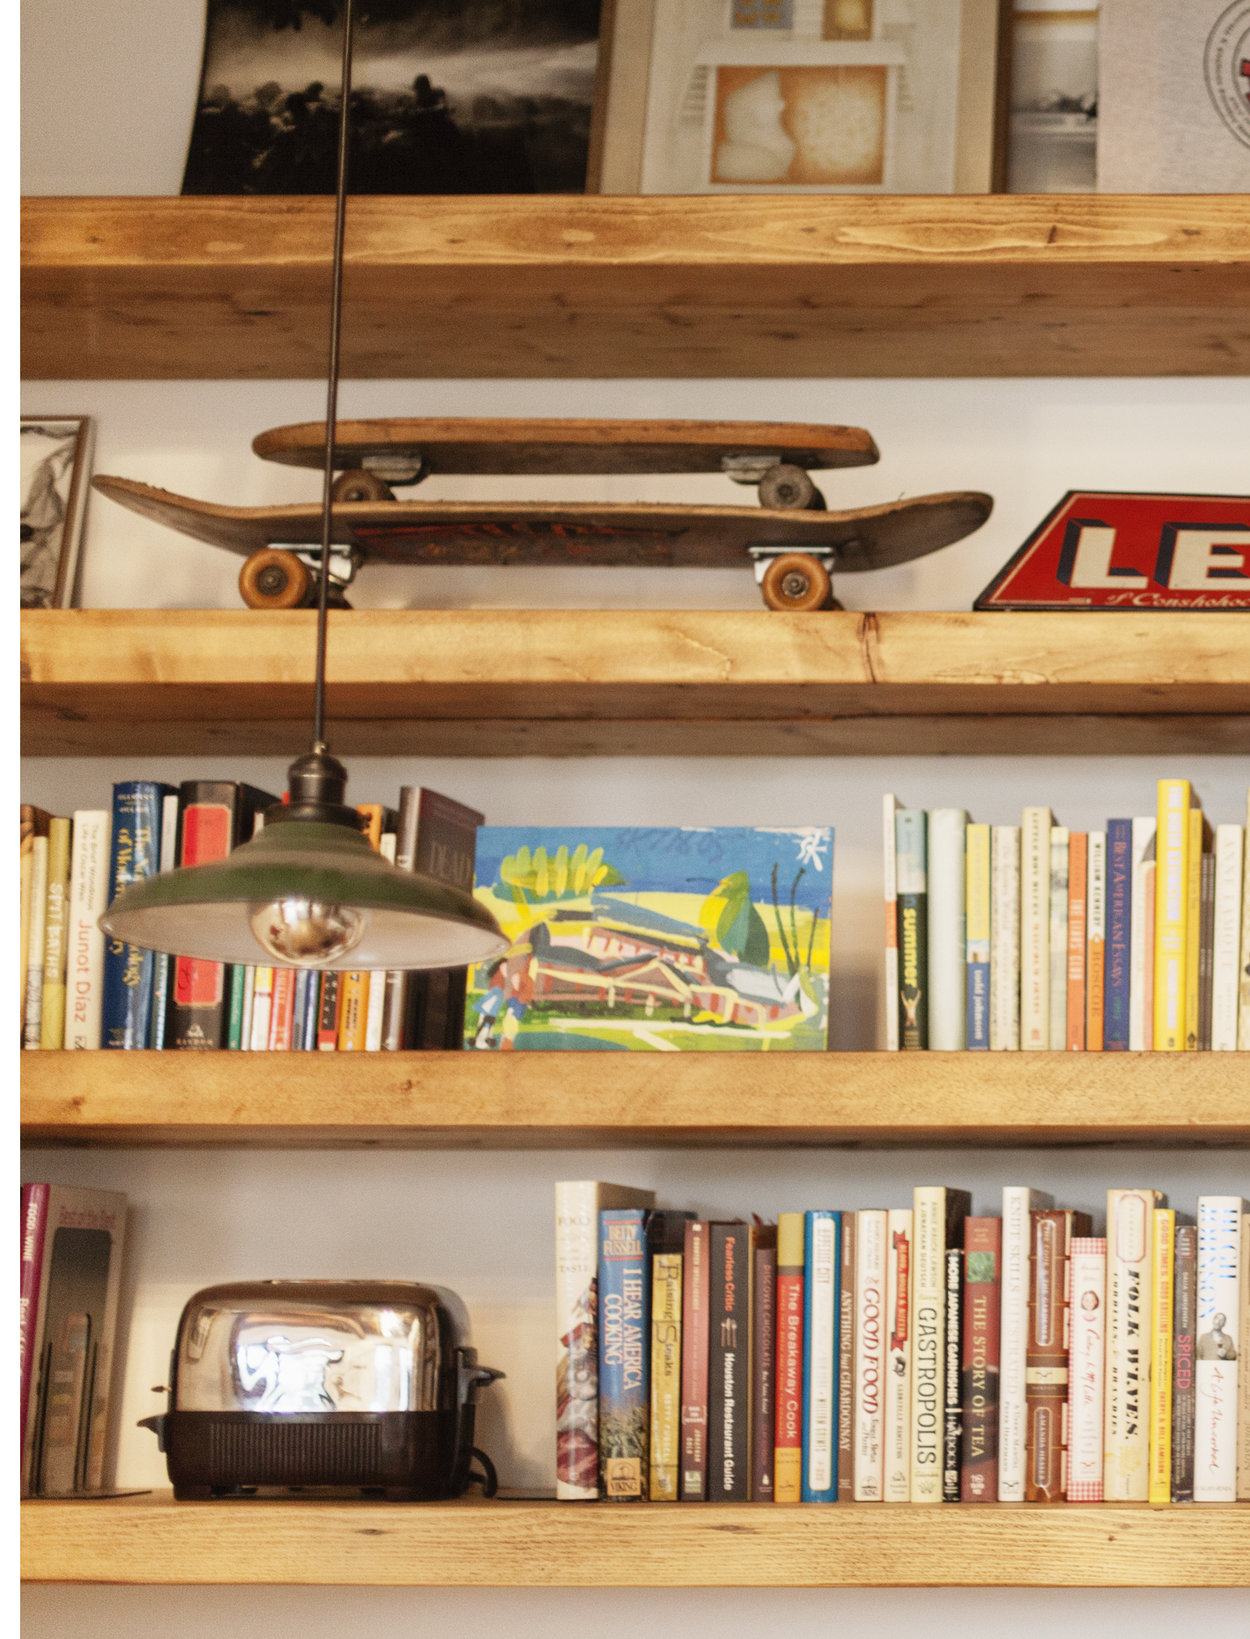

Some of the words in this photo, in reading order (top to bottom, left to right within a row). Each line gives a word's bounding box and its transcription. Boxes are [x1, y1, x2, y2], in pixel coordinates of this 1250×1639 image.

[1168, 787, 1182, 808] THE
[1168, 813, 1182, 847] SIXTH
[1093, 843, 1101, 882] WILLIAM
[1112, 842, 1127, 869] BEST
[48, 882, 63, 918] SPIT
[1167, 850, 1180, 920] EXTINCTION
[47, 925, 63, 979] BATHS
[76, 920, 90, 973] Junot
[903, 908, 919, 988] summer
[1111, 944, 1126, 987] ESSAYS
[74, 981, 92, 1023] Díaz
[974, 969, 986, 994] todd
[1092, 952, 1101, 1017] ROSCOE
[973, 996, 985, 1040] johnson
[27, 1204, 37, 1229] FOOD
[608, 1224, 637, 1241] BETTY
[1010, 1196, 1021, 1239] KNIFE
[1160, 1219, 1169, 1249] GOOD
[23, 1237, 33, 1262] WINE
[603, 1240, 643, 1256] FUSSELL
[725, 1237, 735, 1281] Fearless
[1009, 1245, 1021, 1292] SKILLS
[659, 1263, 679, 1319] Raising
[949, 1257, 959, 1289] MORE
[623, 1280, 641, 1318] HEAR
[725, 1283, 735, 1311] Critic
[788, 1283, 799, 1312] The
[948, 1291, 959, 1341] JAPANESE
[973, 1295, 987, 1330] THE
[1127, 1269, 1140, 1337] FOLK
[605, 1294, 620, 1364] COOKING
[841, 1291, 851, 1351] ANYTHING
[863, 1288, 880, 1351] GOOD
[623, 1324, 641, 1390] AMERICA
[657, 1325, 678, 1376] Steaks
[786, 1315, 799, 1395] Breakaway
[841, 1353, 851, 1369] but
[972, 1336, 986, 1389] STORY
[1177, 1335, 1192, 1388] SPICED
[724, 1352, 735, 1396] Houston
[863, 1354, 879, 1414] FOOD
[917, 1307, 937, 1465] GASTROPOLIS
[947, 1344, 958, 1404] GARNISHES
[1125, 1348, 1139, 1440] WINES.
[724, 1399, 735, 1457] Restaurant
[786, 1400, 798, 1438] Cook
[840, 1372, 850, 1450] CHARDONNAY
[972, 1395, 985, 1417] OF
[972, 1424, 985, 1457] TEA
[610, 1482, 639, 1492] VIKING
[723, 1459, 735, 1491] Guide
